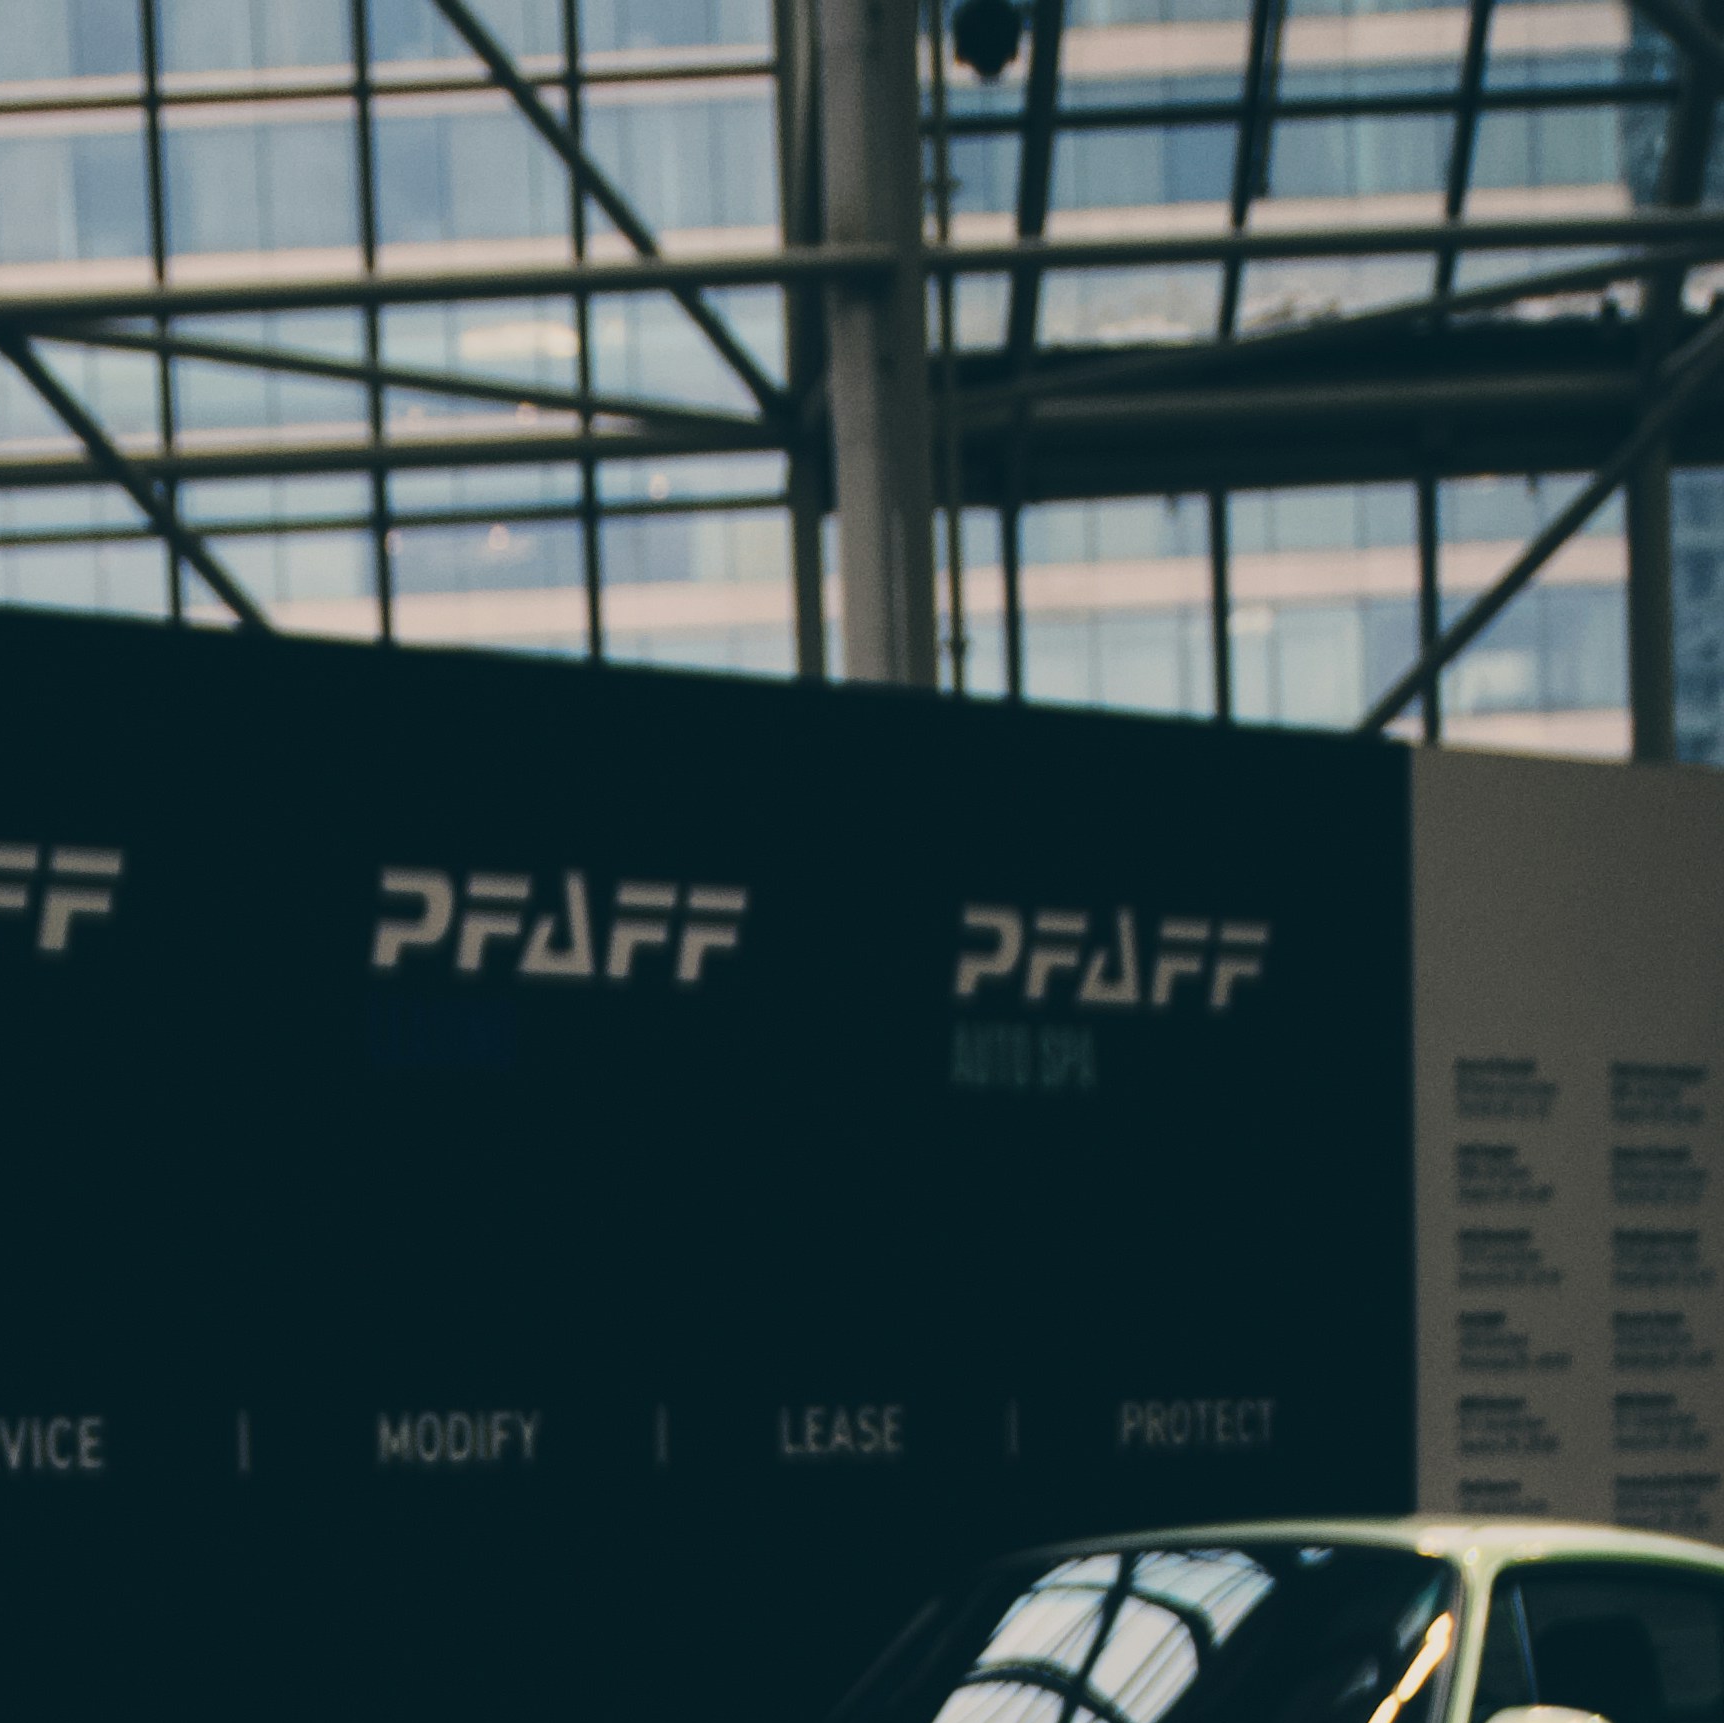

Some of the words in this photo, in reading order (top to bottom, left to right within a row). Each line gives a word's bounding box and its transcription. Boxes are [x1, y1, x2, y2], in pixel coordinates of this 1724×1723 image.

[372, 869, 747, 983] PFAFF
[954, 905, 1269, 1009] PFAFF
[376, 1410, 538, 1465] MODIFY
[779, 1404, 902, 1458] LEASE
[1118, 1398, 1275, 1448] PROTECT
